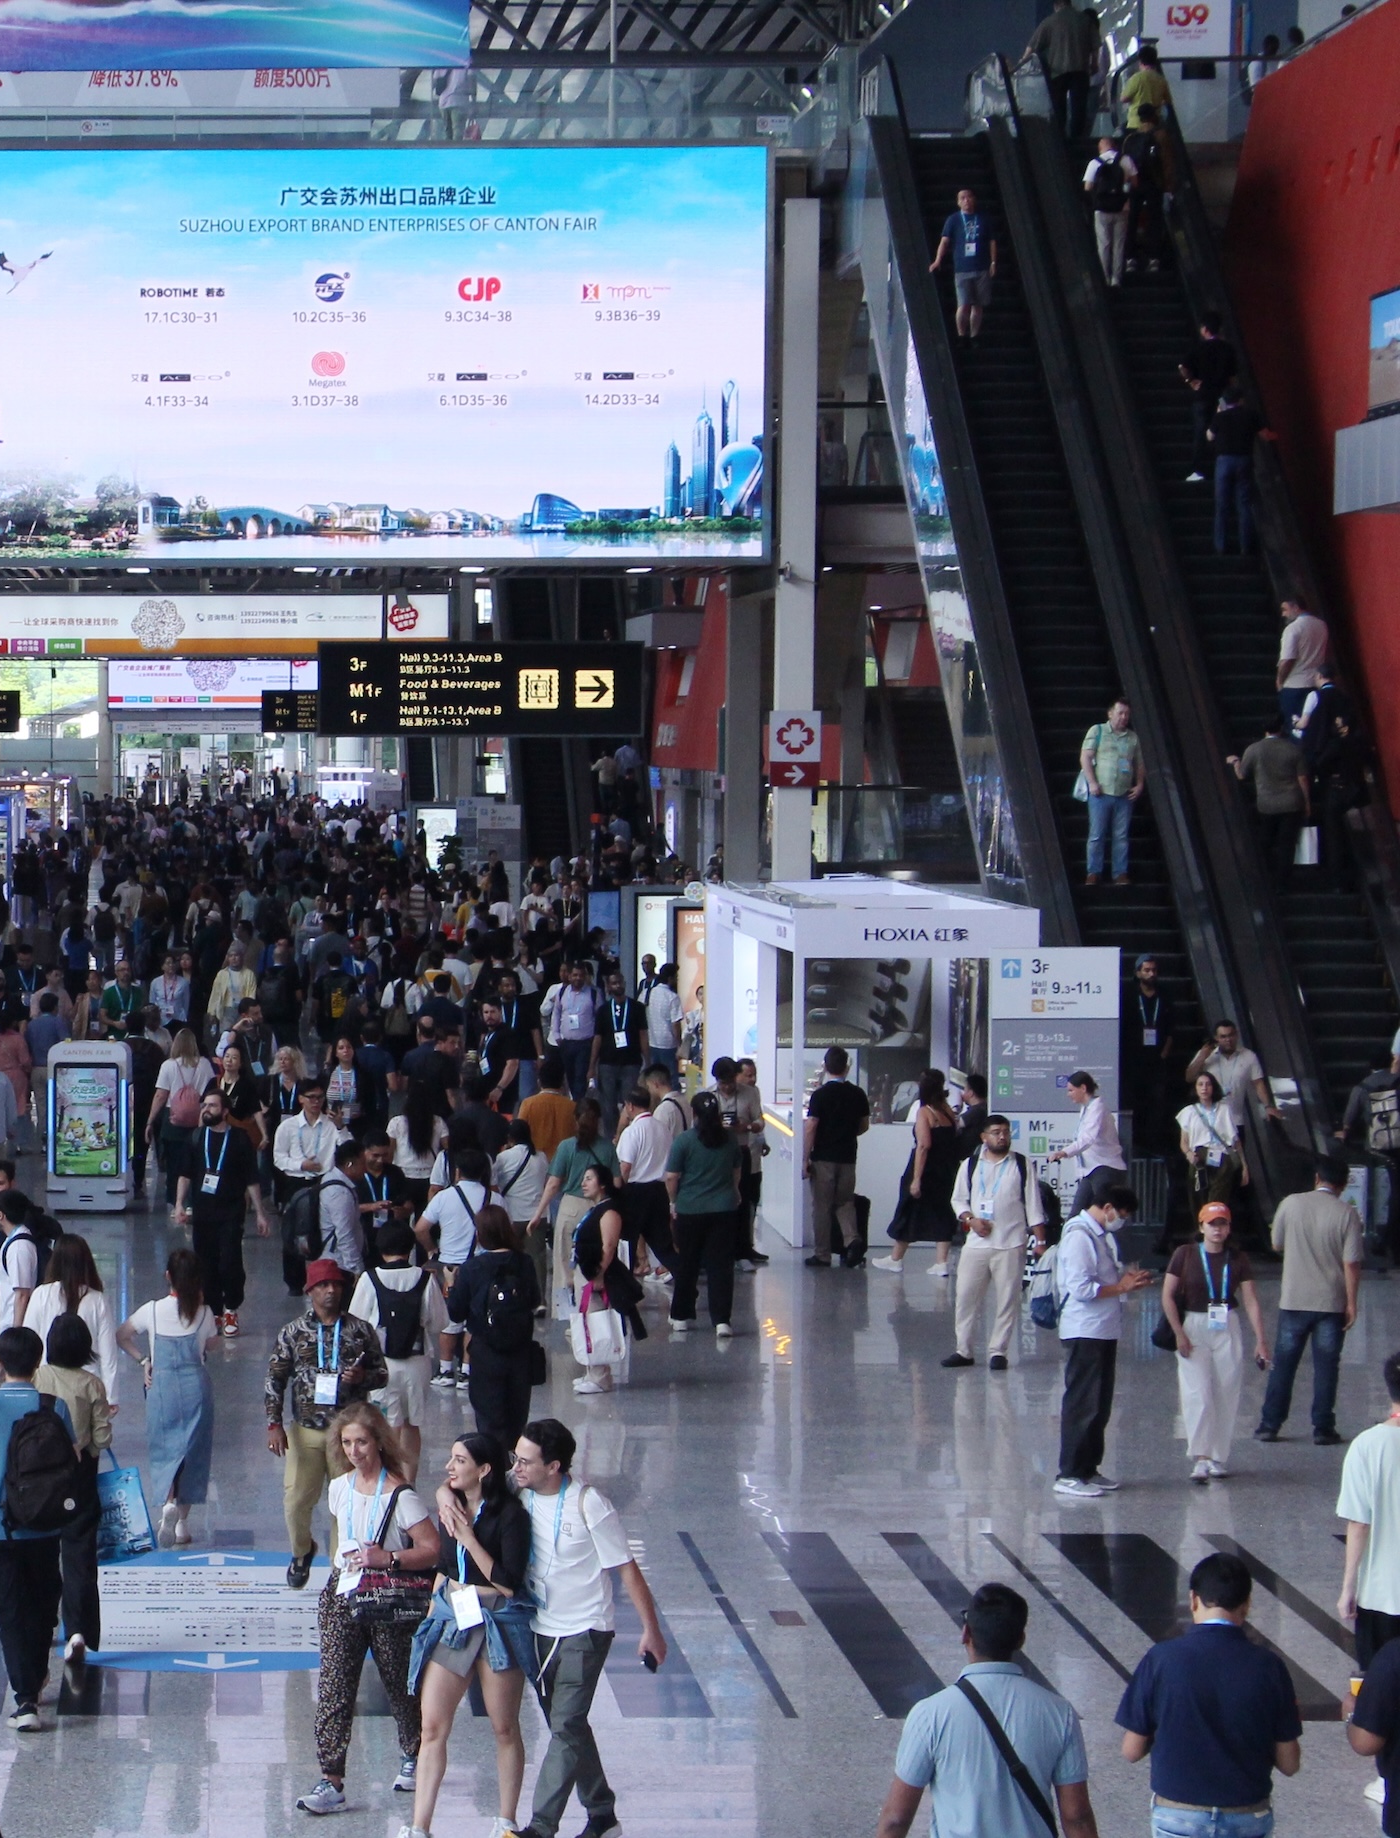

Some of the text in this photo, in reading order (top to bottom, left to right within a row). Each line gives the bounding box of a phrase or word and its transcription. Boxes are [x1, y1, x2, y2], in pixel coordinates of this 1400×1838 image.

[280, 187, 496, 206] 广交会苏州出口品牌企业
[179, 217, 597, 233] SUZHOU EXPORT BRAND ENTERPRISES OF CANTON FAIR
[140, 288, 199, 298] ROBOTIME
[458, 277, 501, 302] CJP
[144, 312, 218, 323] 17.1C30-31
[292, 311, 367, 323] 10.2C35-36
[444, 311, 512, 322] 9.3C34-38
[595, 310, 661, 322] 9.3B36-39
[309, 379, 346, 389] Megatex
[145, 396, 208, 407] 4.1F33-34
[291, 395, 359, 407] 3.1D37-38
[440, 395, 507, 406] 6.1D35-36
[585, 394, 660, 405] 14.2D33-34
[400, 653, 420, 663] Hall
[494, 653, 502, 663] B
[350, 657, 367, 672] 3F
[349, 683, 382, 698] M1F
[400, 679, 501, 691] Food & Beverages
[350, 709, 367, 724] 1F
[400, 705, 420, 716] Hall
[494, 705, 502, 715] B
[864, 927, 929, 942] HOXIA
[1031, 959, 1050, 974] 3F
[1052, 982, 1102, 995] 9.3-11.3
[807, 1037, 836, 1047] support
[837, 1037, 871, 1047] massage
[1002, 1040, 1020, 1056] 2F
[1029, 1120, 1054, 1132] M1F
